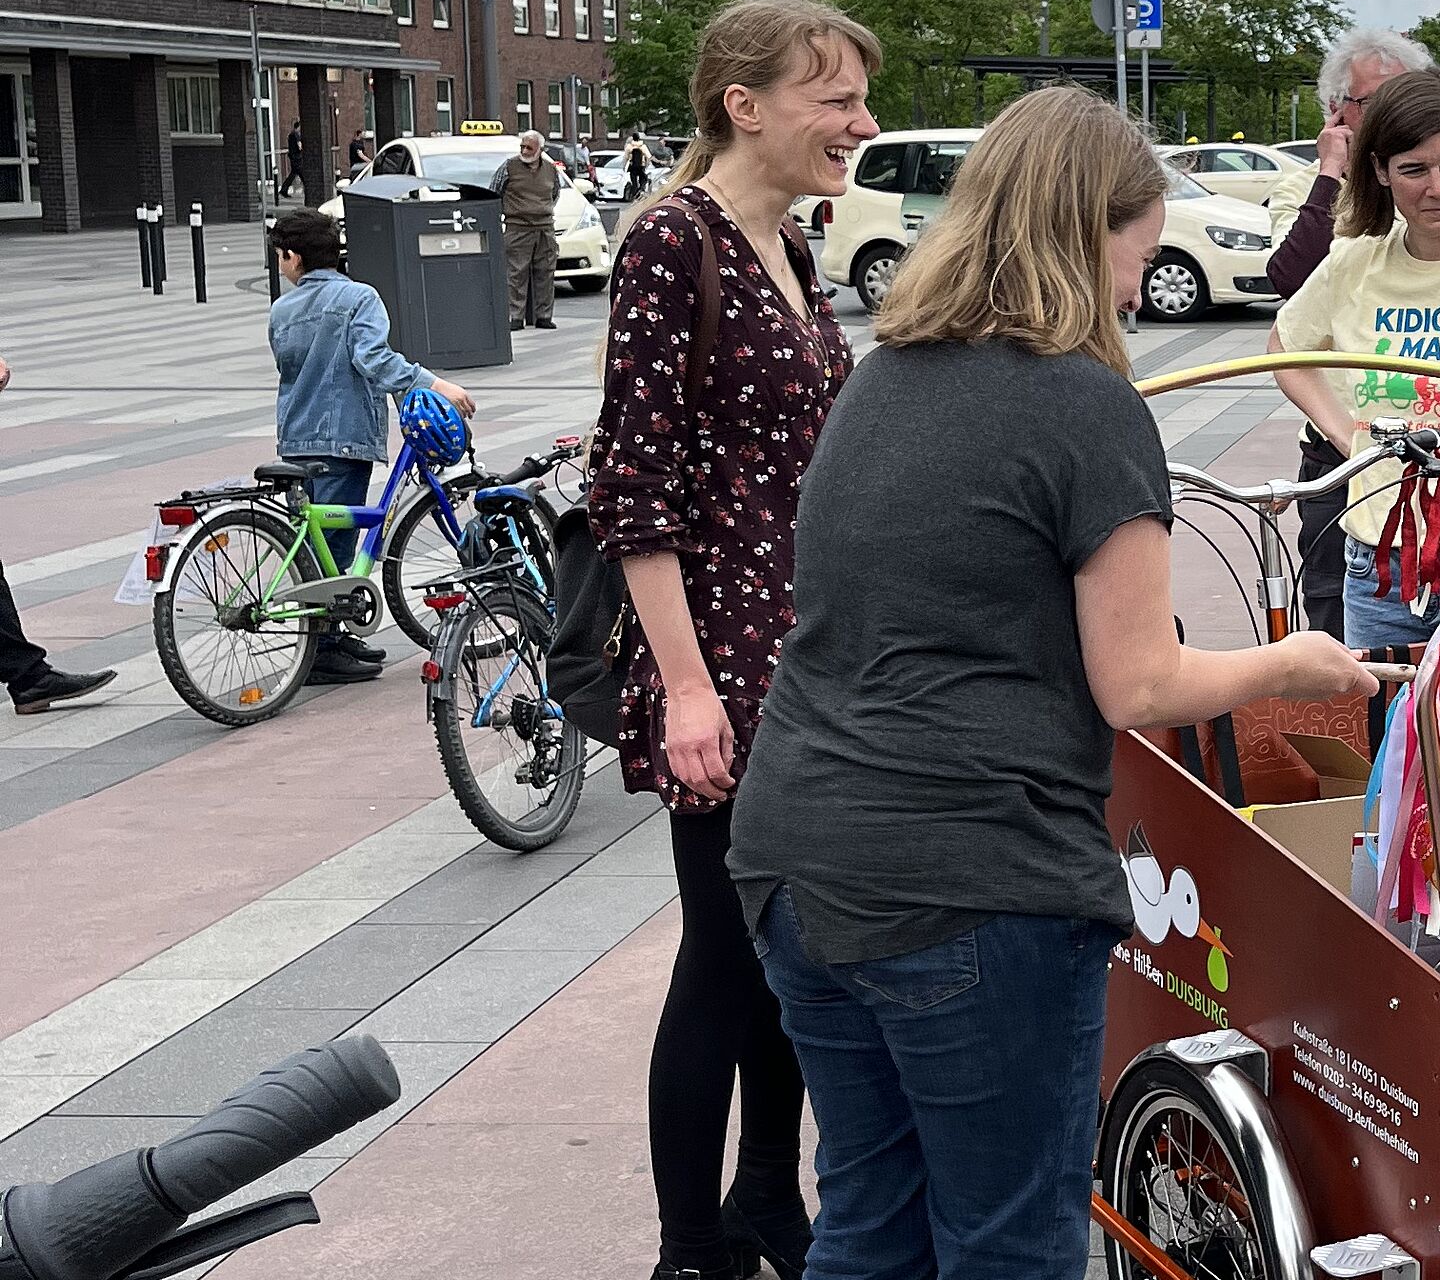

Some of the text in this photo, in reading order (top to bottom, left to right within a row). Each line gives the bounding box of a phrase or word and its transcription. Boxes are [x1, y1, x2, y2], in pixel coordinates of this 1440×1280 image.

[1133, 948, 1164, 988] Hilfen
[1166, 970, 1229, 1029] DUISBURG
[1292, 1020, 1334, 1058] Kuhstraße
[1335, 1047, 1346, 1066] 18
[1351, 1059, 1378, 1087] 47051
[1380, 1076, 1419, 1117] Duisburg
[1292, 1070, 1317, 1095] www.
[1292, 1044, 1322, 1074] Telefon
[1323, 1064, 1345, 1088] 0203
[1351, 1082, 1363, 1100] 34
[1363, 1091, 1375, 1109] 69
[1376, 1099, 1402, 1127] 98-16
